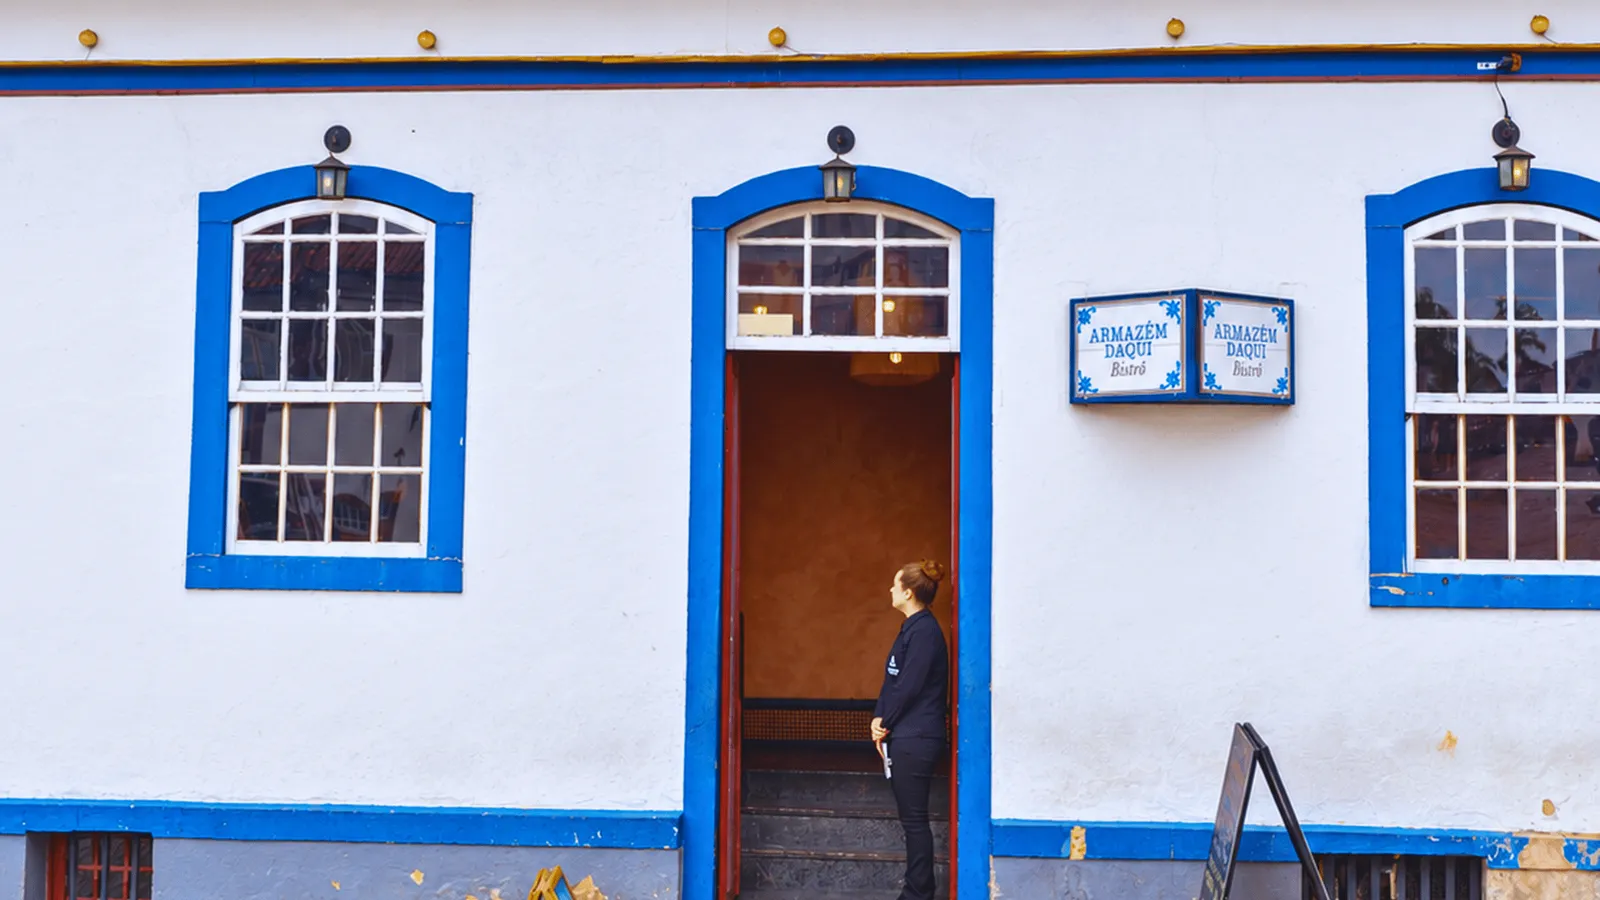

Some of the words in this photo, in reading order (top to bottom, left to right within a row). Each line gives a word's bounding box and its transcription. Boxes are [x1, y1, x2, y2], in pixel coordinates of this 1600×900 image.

[1088, 320, 1168, 344] ARMAZÉM
[1214, 323, 1277, 344] ARMAZÉM
[1104, 341, 1152, 360] DAQUI
[1226, 341, 1266, 360] DAQUI
